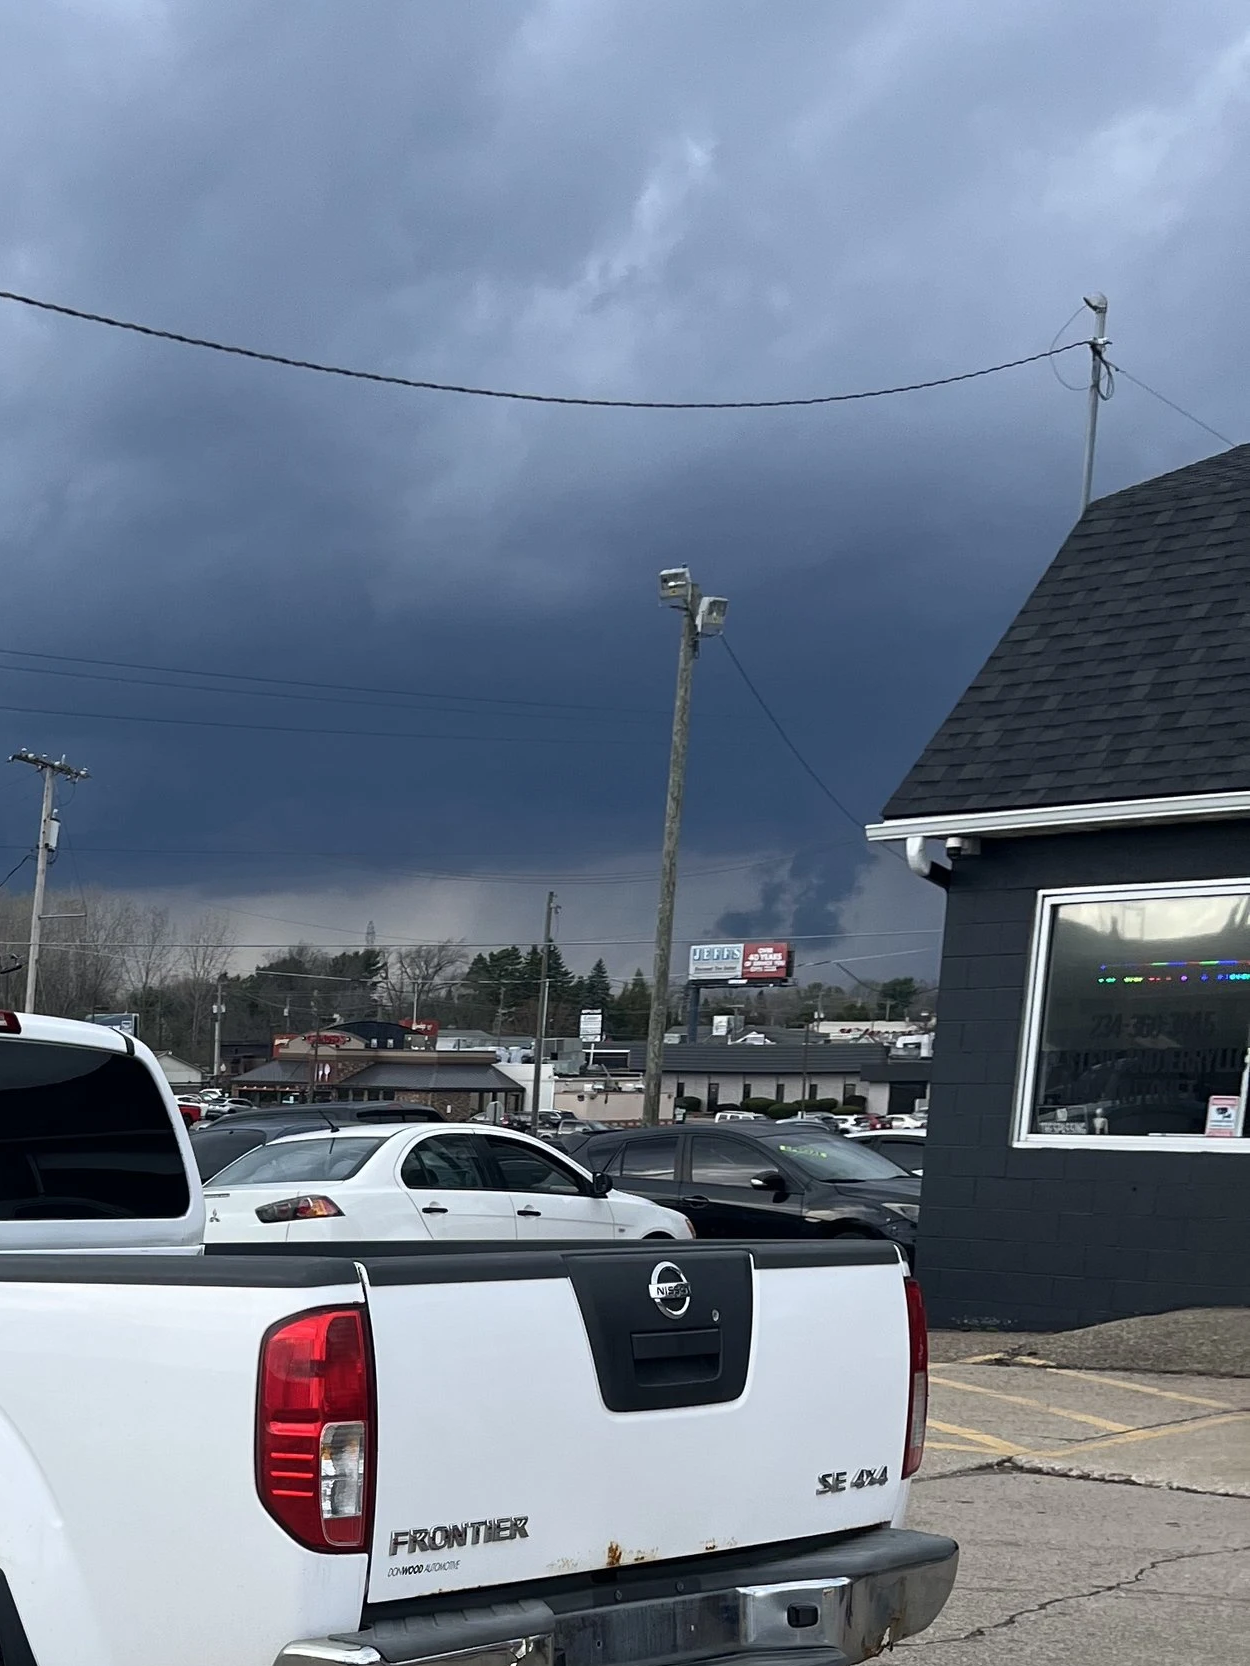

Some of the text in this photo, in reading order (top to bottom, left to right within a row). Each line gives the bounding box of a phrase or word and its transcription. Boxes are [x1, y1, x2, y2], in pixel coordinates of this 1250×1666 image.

[656, 1284, 689, 1296] NISS
[815, 1471, 847, 1496] SE
[389, 1515, 530, 1557] FRONTIER
[424, 1560, 461, 1573] AUTOMOTIVE
